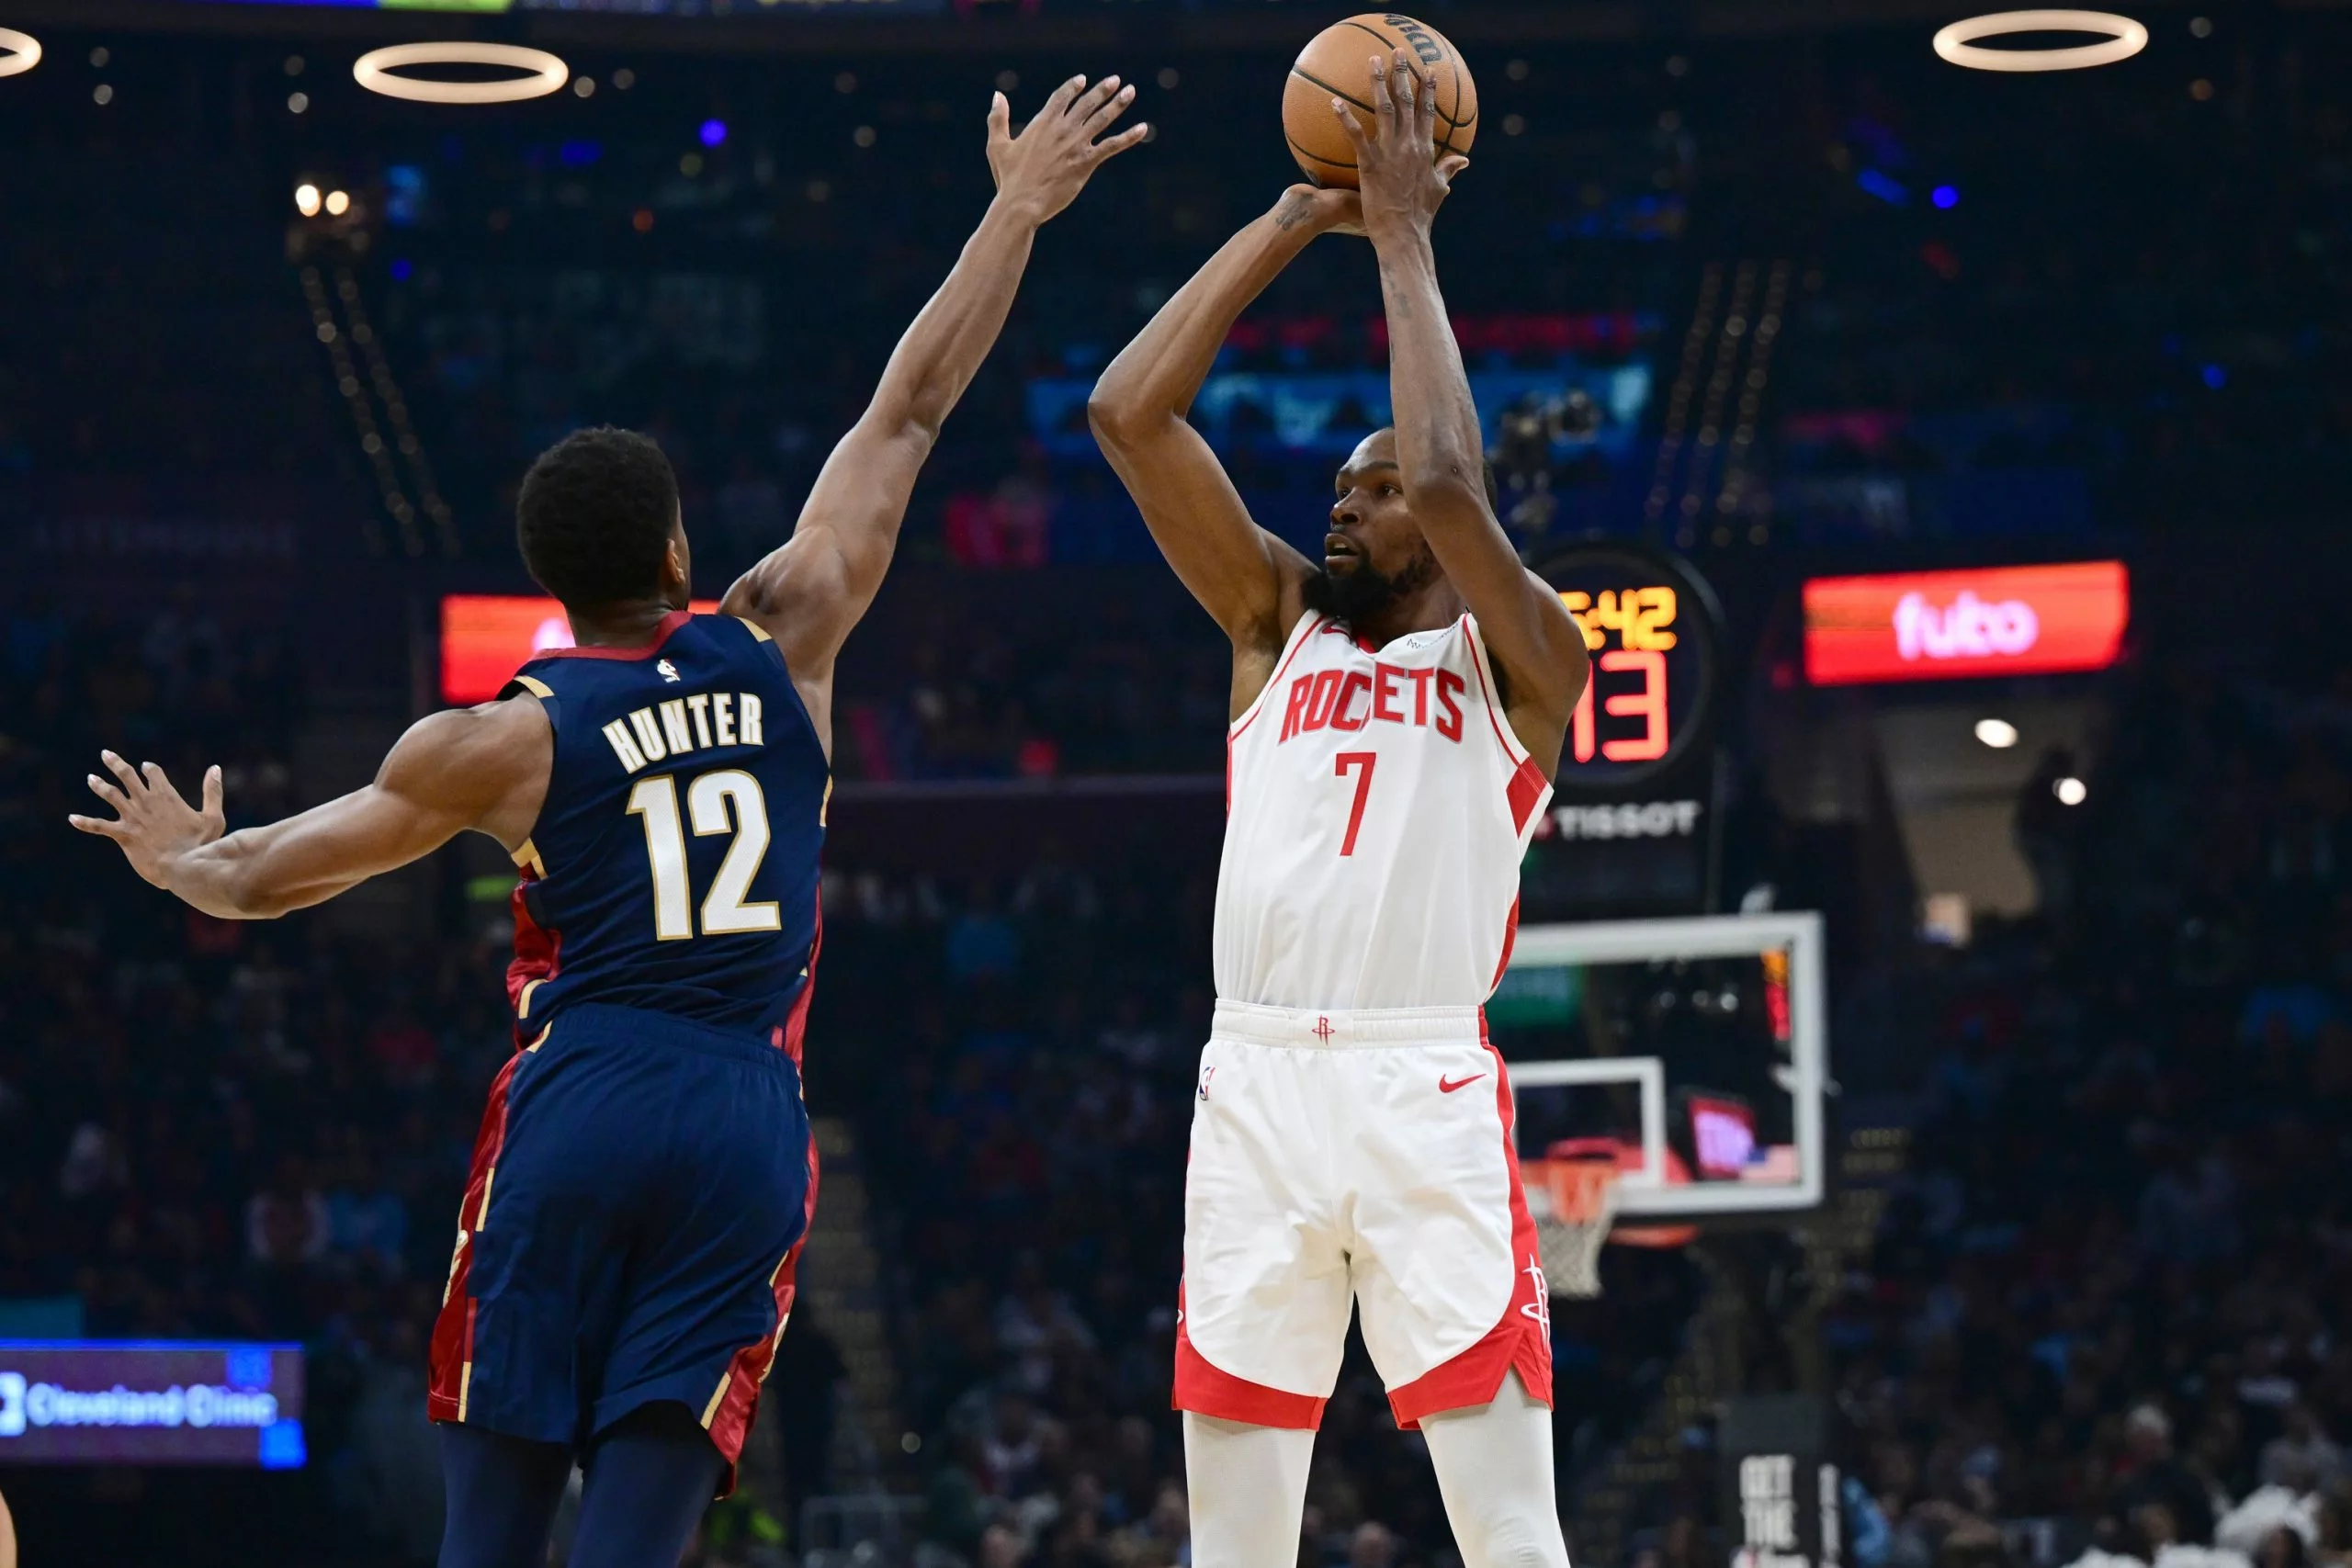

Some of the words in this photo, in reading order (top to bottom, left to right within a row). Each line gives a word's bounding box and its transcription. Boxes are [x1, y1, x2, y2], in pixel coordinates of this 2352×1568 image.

[1893, 590, 2041, 660] fubo
[601, 692, 764, 774] HUNTER
[1277, 660, 1466, 745] ROCETS
[1335, 751, 1377, 856] 7
[1555, 798, 1702, 840] TISSOT
[625, 769, 782, 942] 12
[27, 1382, 184, 1427] Cleveland
[186, 1383, 277, 1428] Clinic
